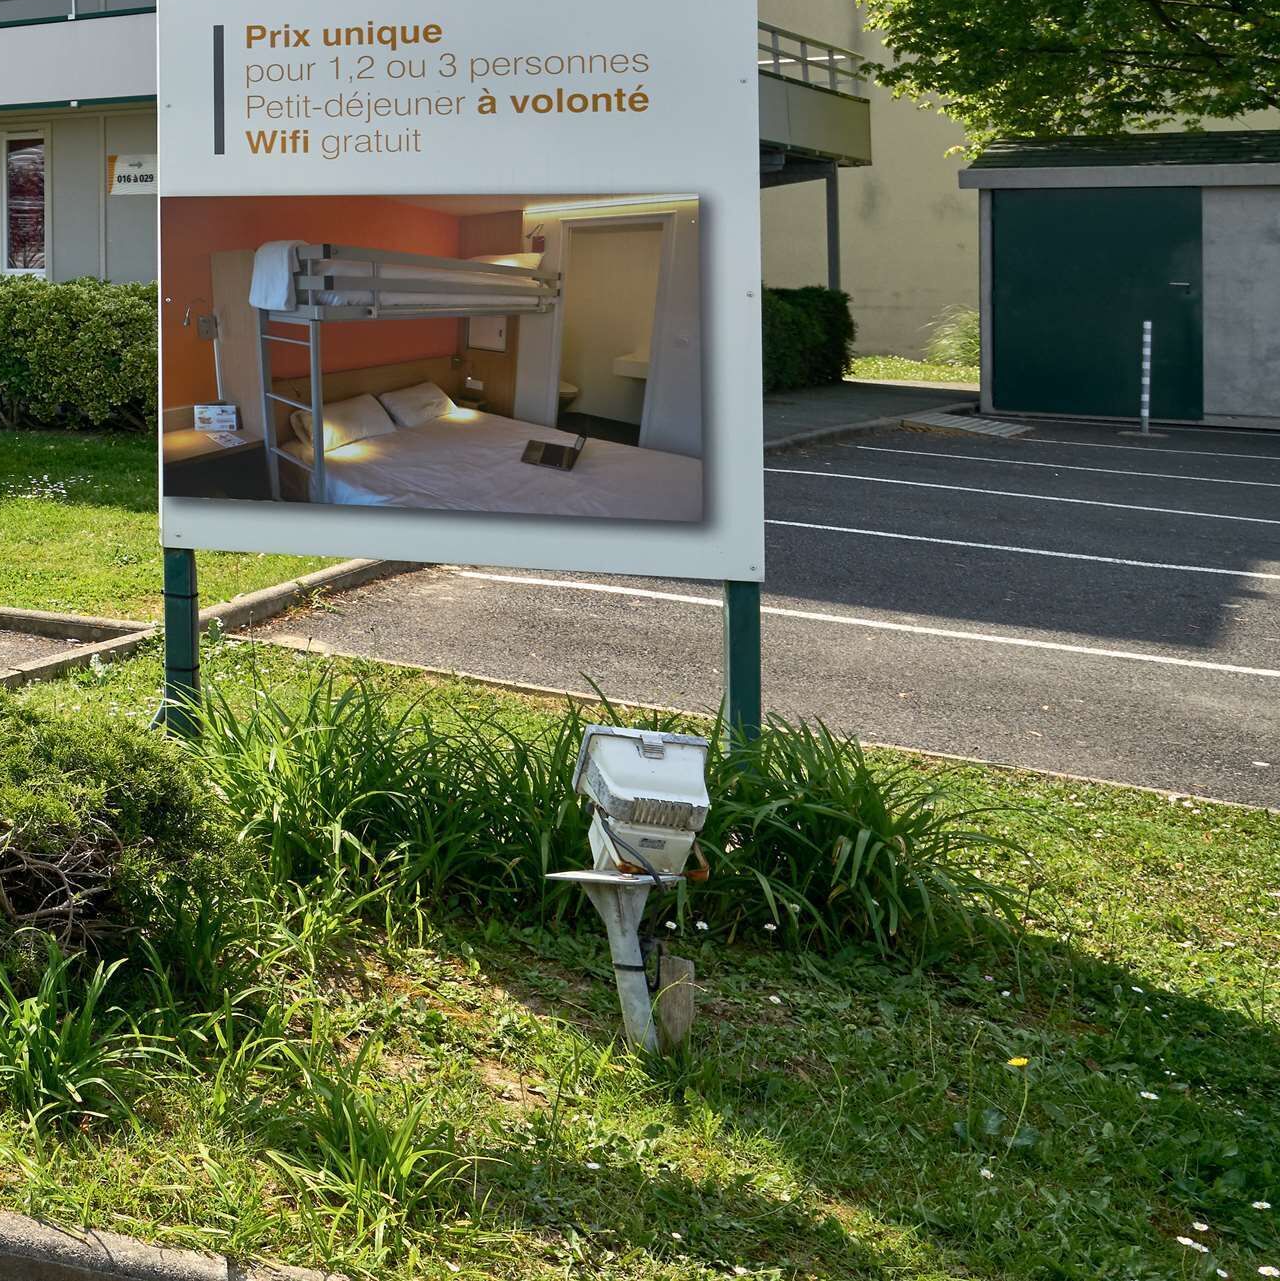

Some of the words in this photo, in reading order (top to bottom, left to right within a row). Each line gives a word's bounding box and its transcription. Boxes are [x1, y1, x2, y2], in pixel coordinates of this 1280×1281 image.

[245, 23, 311, 49] Prix
[321, 20, 444, 56] unique
[245, 60, 316, 89] pour
[332, 56, 376, 84] 1,2
[386, 60, 427, 81] ou
[438, 53, 458, 79] 3
[469, 52, 650, 84] personnes
[245, 90, 465, 125] Petit-déjeuner
[477, 87, 497, 115] à
[510, 85, 650, 114] volonté
[245, 129, 311, 154] Wifi
[321, 129, 422, 160] gratuit
[117, 175, 131, 183] 016
[133, 174, 138, 183] à
[139, 174, 154, 183] 029
